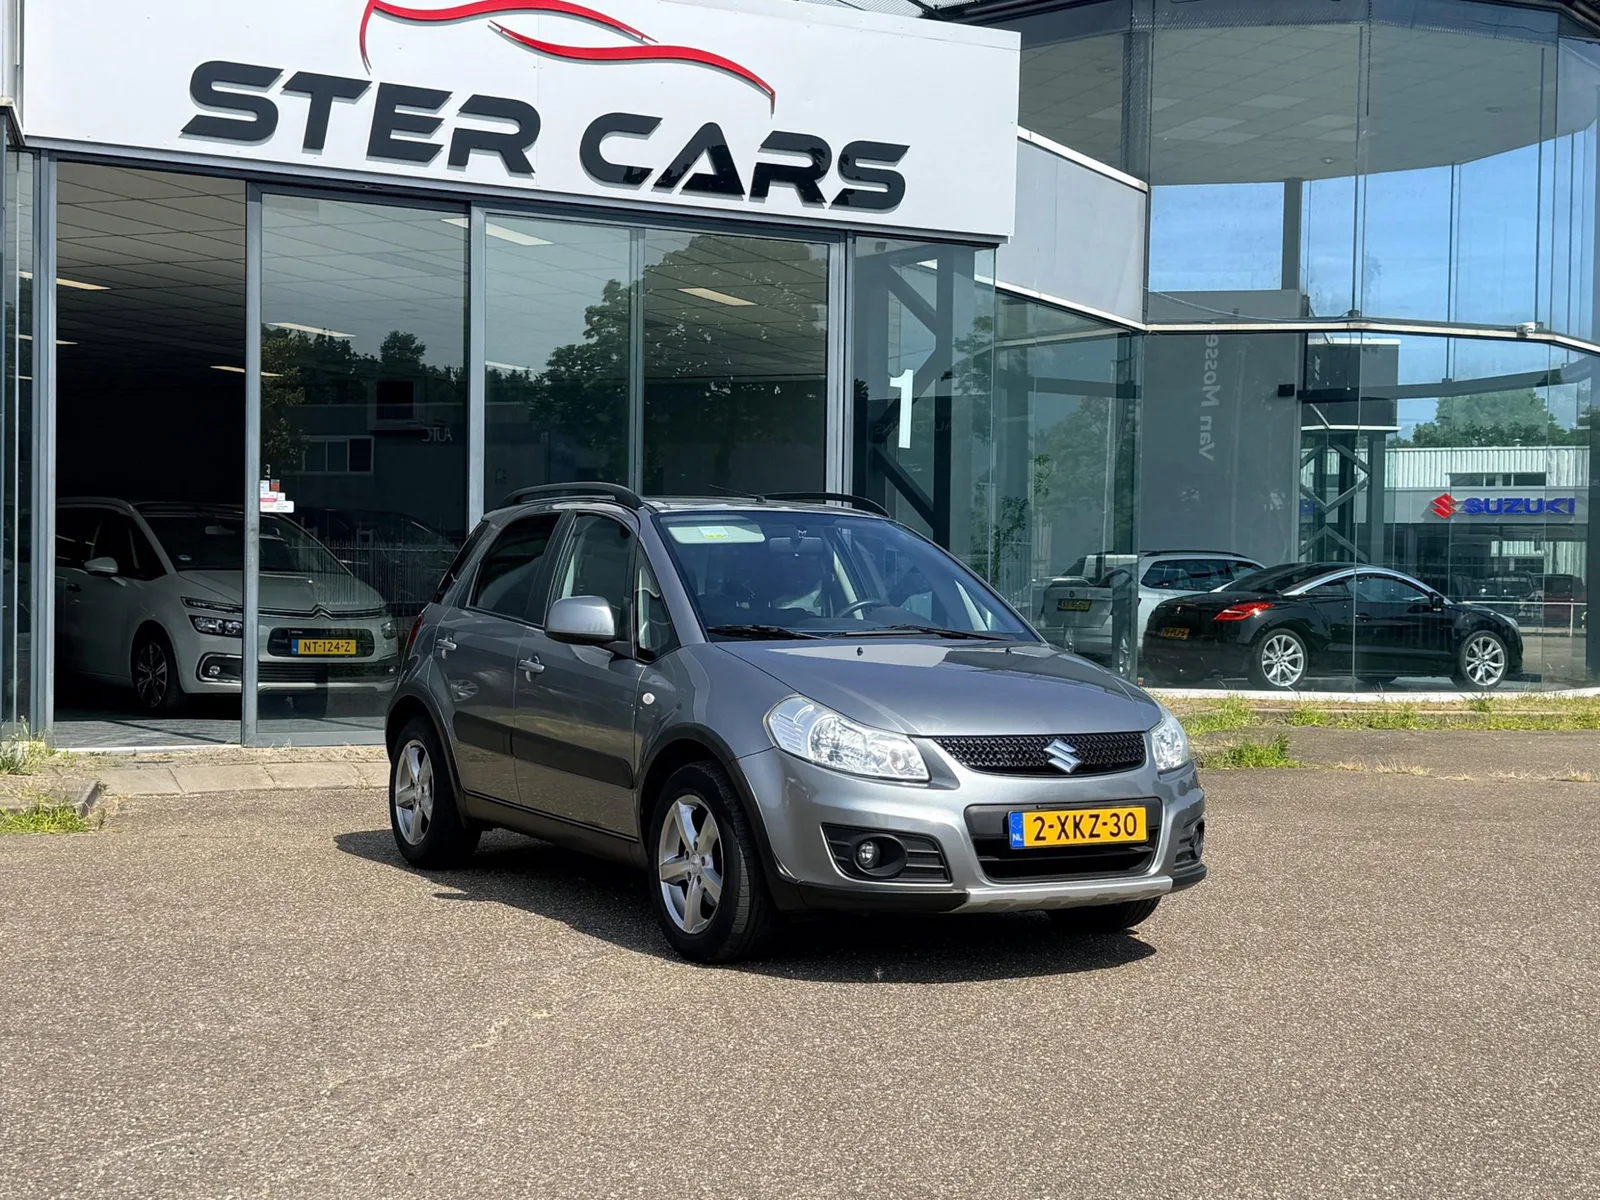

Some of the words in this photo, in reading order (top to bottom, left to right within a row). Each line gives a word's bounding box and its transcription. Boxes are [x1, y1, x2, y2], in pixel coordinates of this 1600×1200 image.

[180, 60, 541, 175] STER
[579, 112, 911, 212] CARS
[889, 368, 914, 449] 1
[1463, 497, 1576, 515] SUZUKI
[303, 641, 351, 653] NT-124-Z
[1033, 811, 1137, 842] 2-XKZ-30
